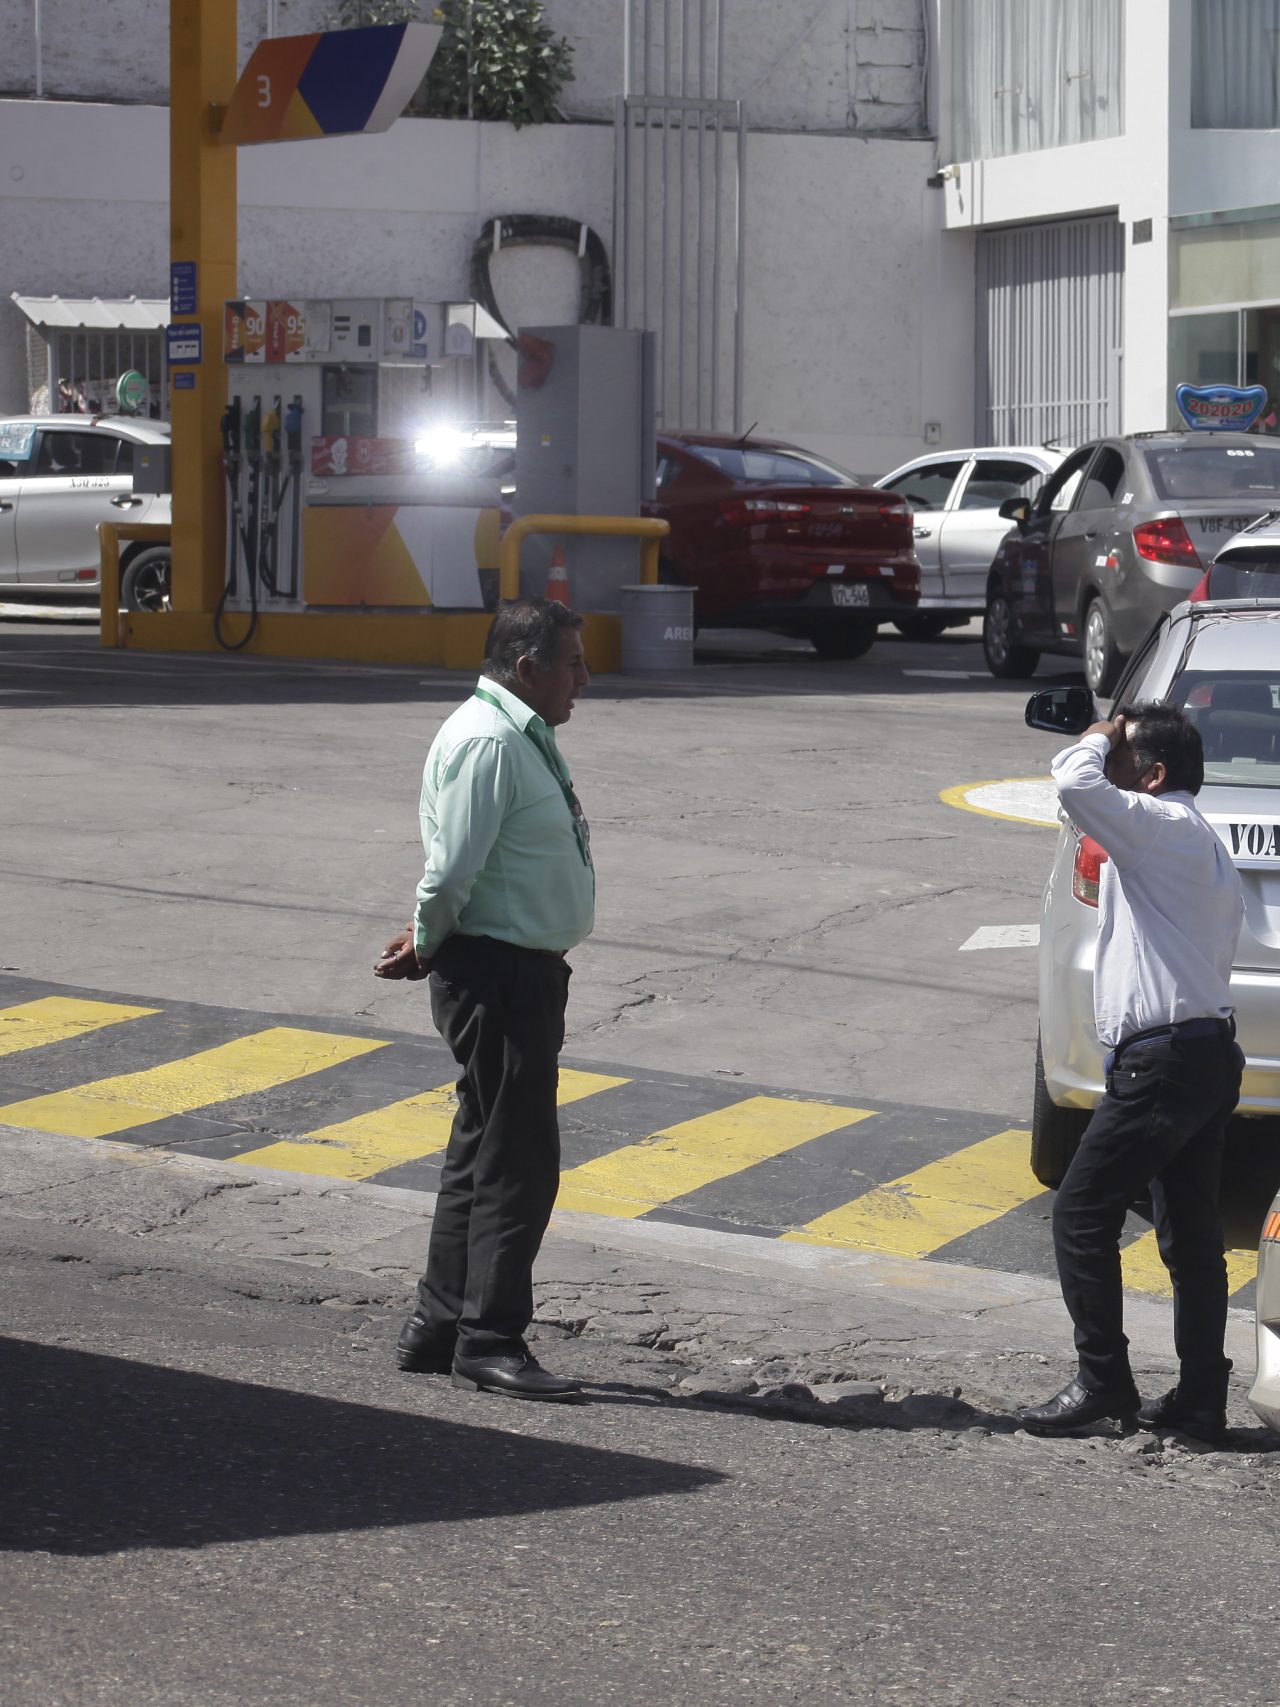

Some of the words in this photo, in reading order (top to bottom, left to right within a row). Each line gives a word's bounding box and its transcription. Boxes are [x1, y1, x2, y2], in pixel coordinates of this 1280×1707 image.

[257, 75, 272, 108] 3
[246, 317, 265, 336] 90
[287, 316, 305, 334] 95
[1189, 399, 1253, 417] 202020
